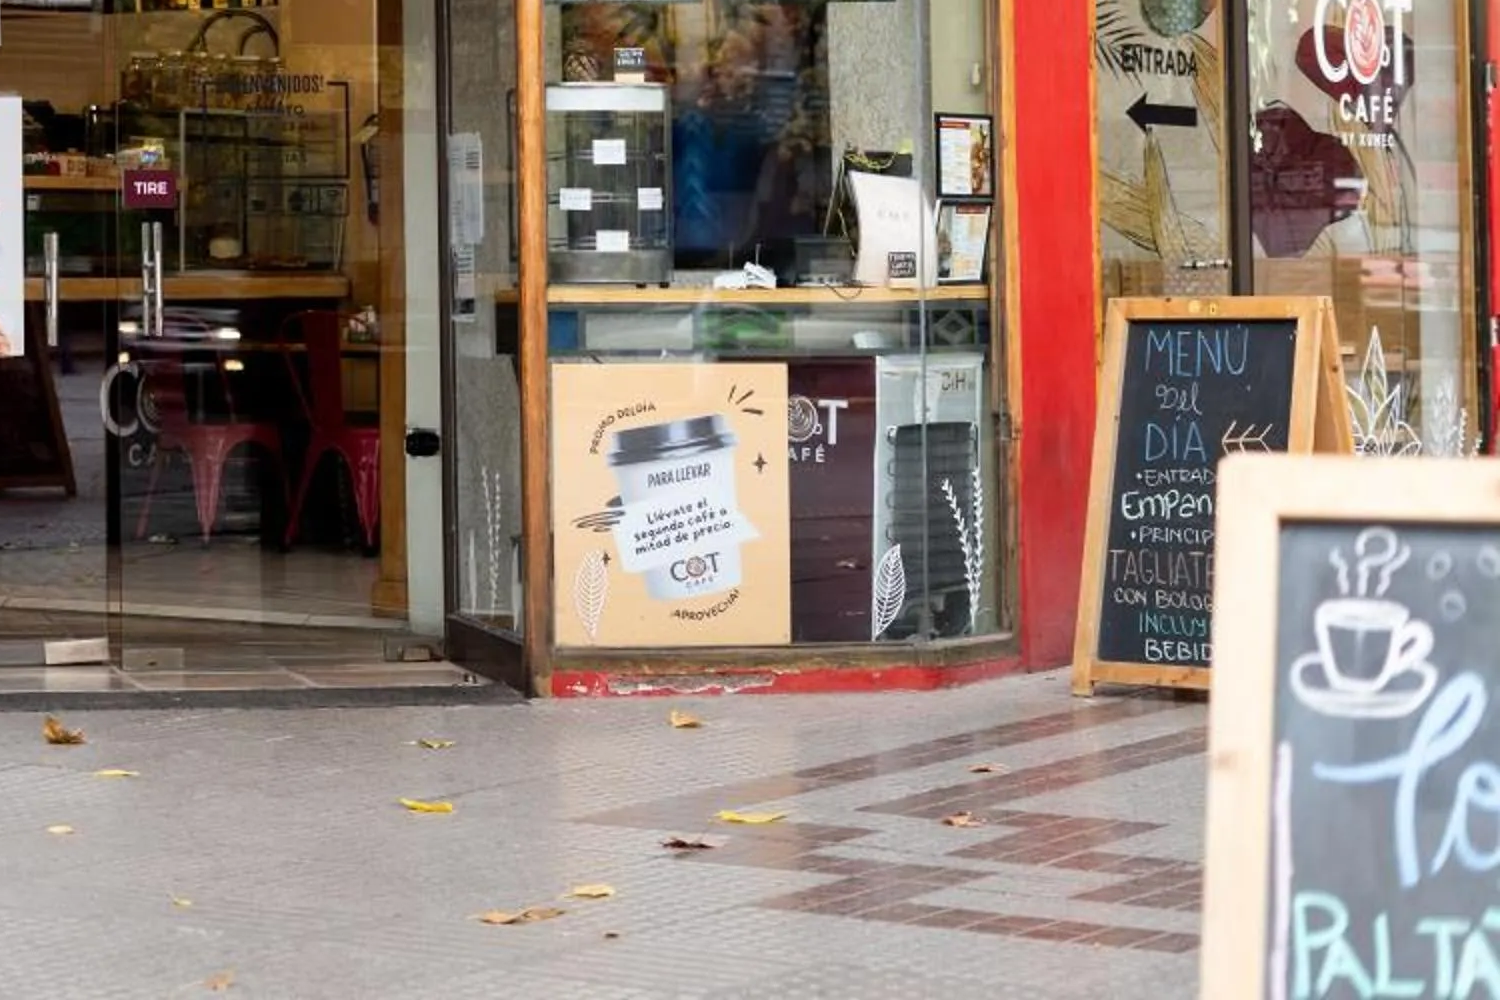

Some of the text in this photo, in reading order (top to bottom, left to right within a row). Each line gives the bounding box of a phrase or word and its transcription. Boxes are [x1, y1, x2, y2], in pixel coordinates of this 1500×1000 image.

[1121, 44, 1200, 77] ENTRADA
[1339, 87, 1393, 123] CAFÉ
[134, 181, 168, 195] TIRE
[788, 394, 848, 445] OT
[590, 414, 616, 455] PROMO
[1145, 416, 1207, 462] DÍA
[788, 444, 825, 463] AFÉ
[647, 462, 711, 487] PARA LLEVAR
[633, 520, 685, 542] segundo
[687, 508, 716, 526] café
[646, 497, 708, 525] Llévate el
[635, 535, 672, 555] mitad
[675, 530, 689, 543] de
[670, 552, 720, 582] COT
[1113, 587, 1147, 605] CON
[1139, 612, 1212, 637] INCLUY
